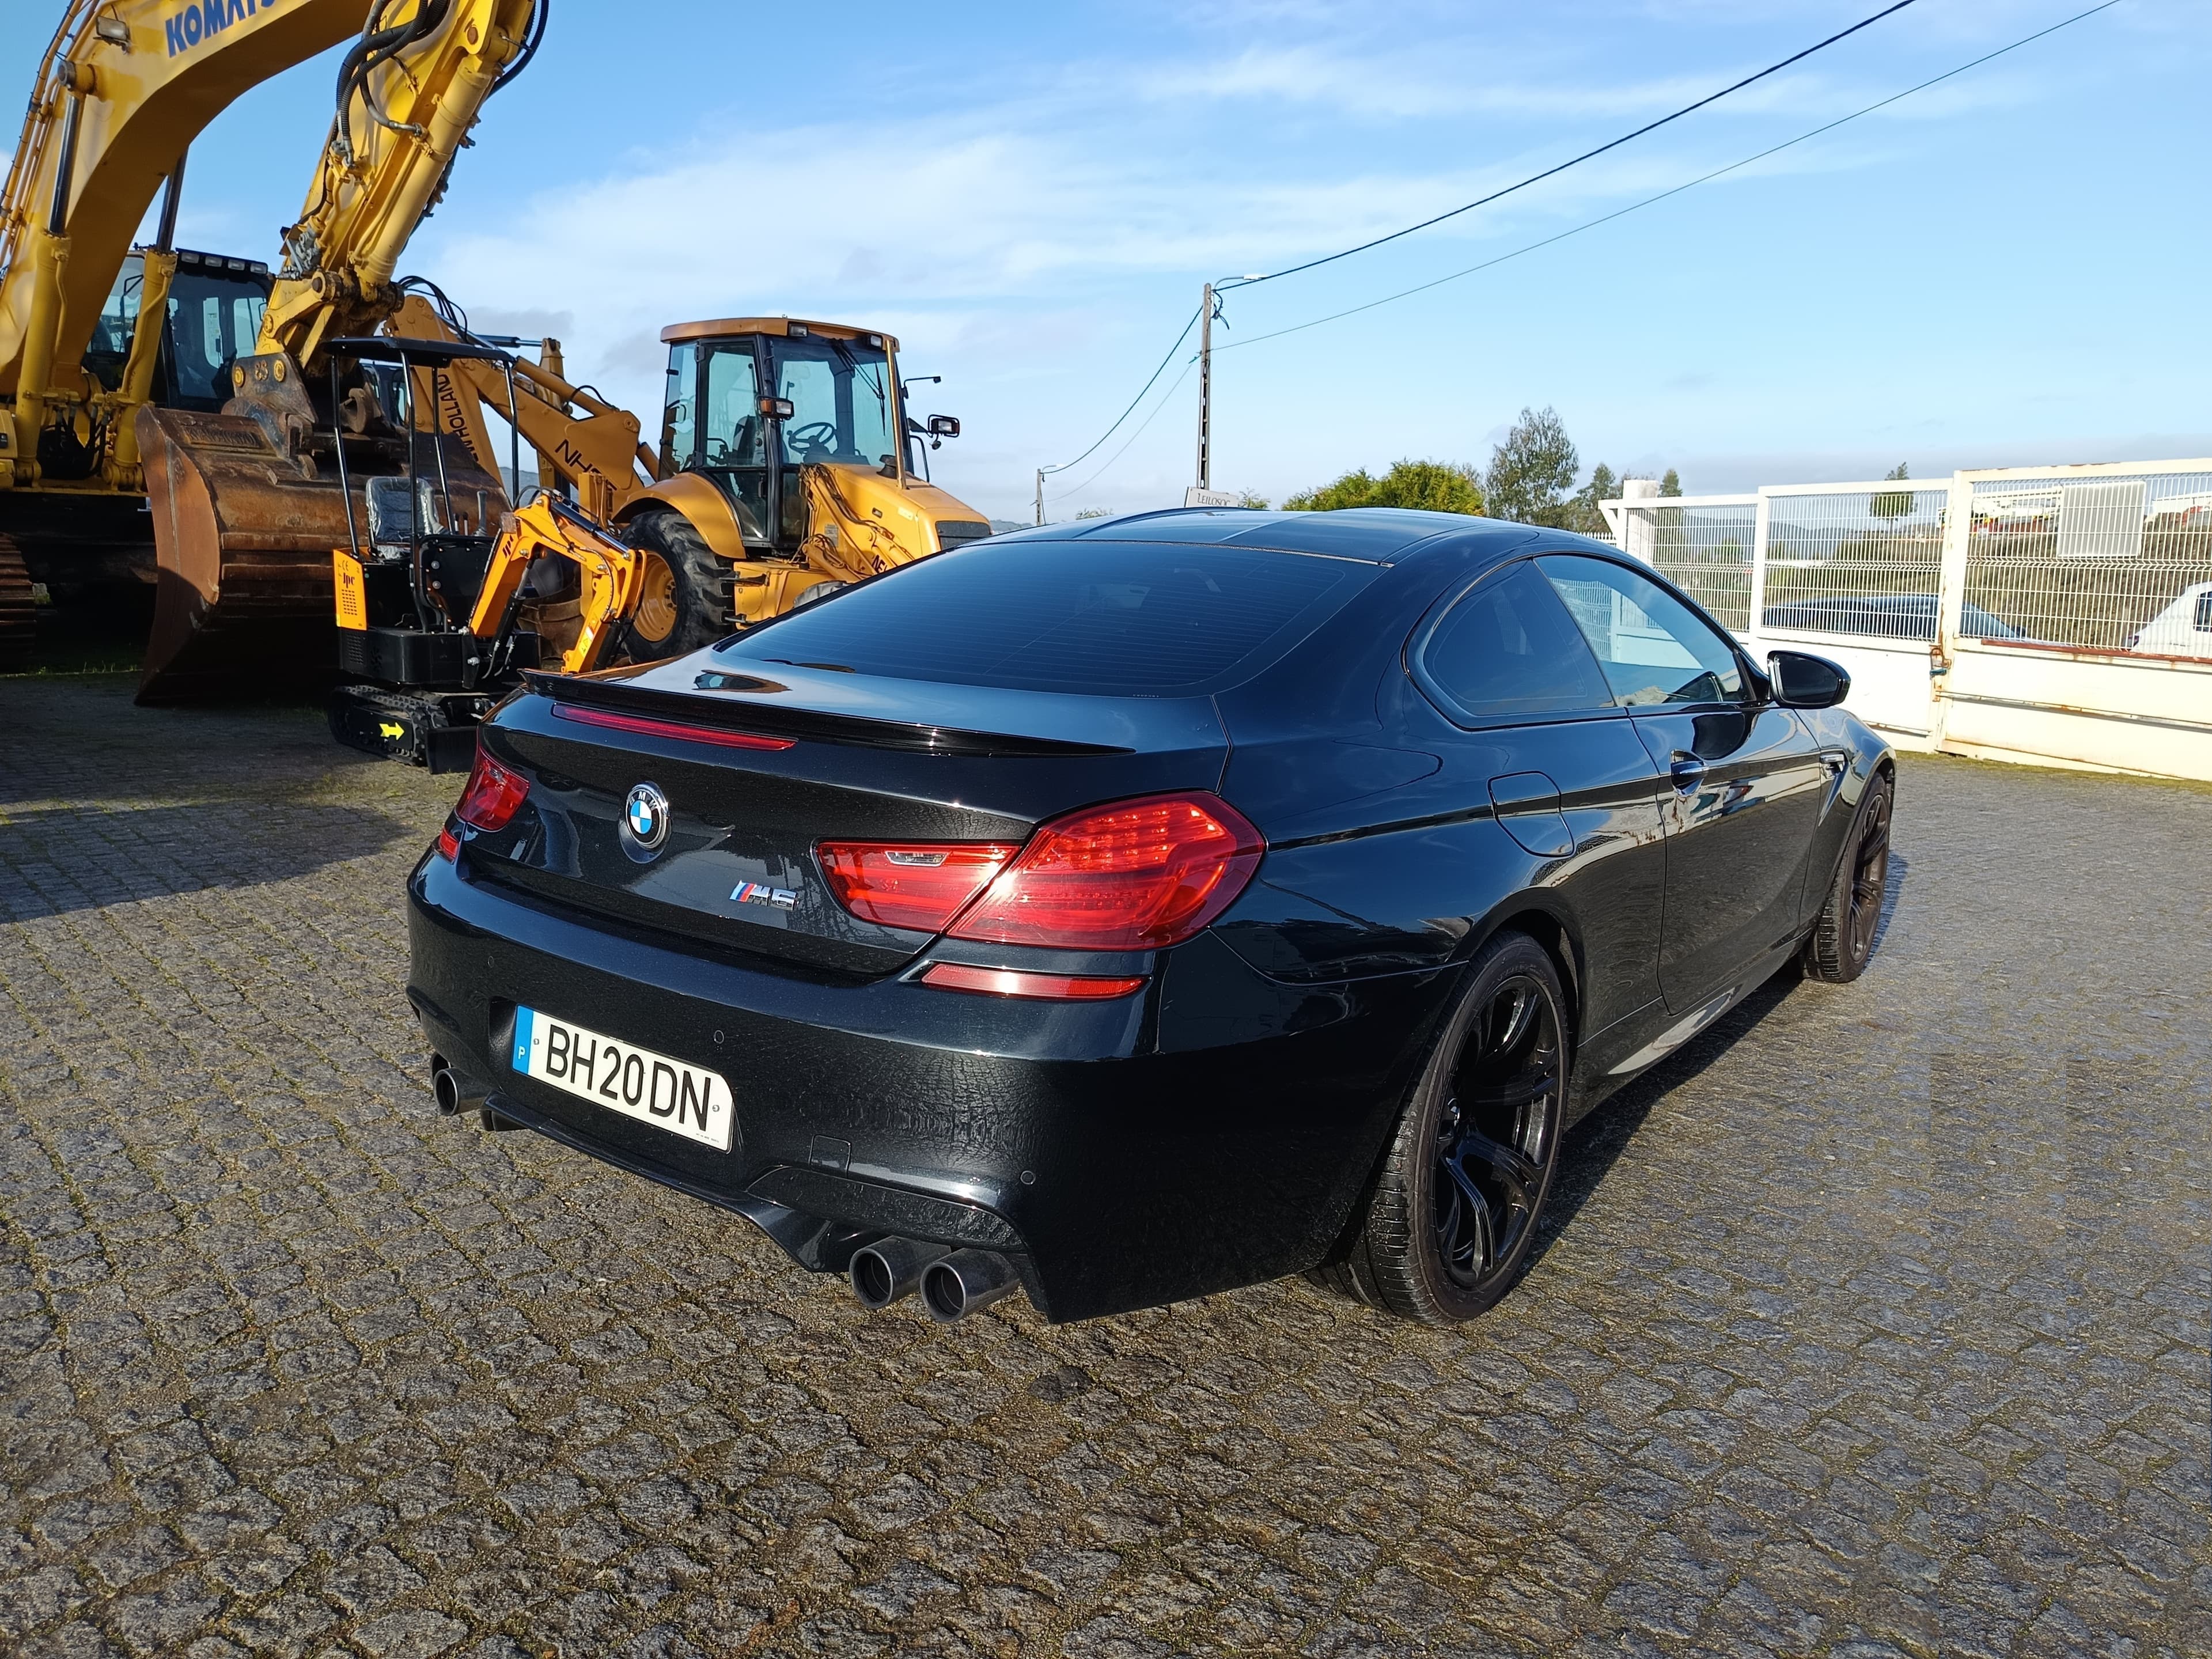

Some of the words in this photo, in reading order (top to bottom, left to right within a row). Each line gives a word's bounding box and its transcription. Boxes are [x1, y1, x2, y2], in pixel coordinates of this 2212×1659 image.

[165, 0, 276, 58] KOMA
[872, 555, 887, 573] NE
[630, 791, 657, 811] BMW
[745, 884, 797, 910] M6
[518, 1046, 525, 1059] P
[546, 1024, 711, 1131] BH20DN
